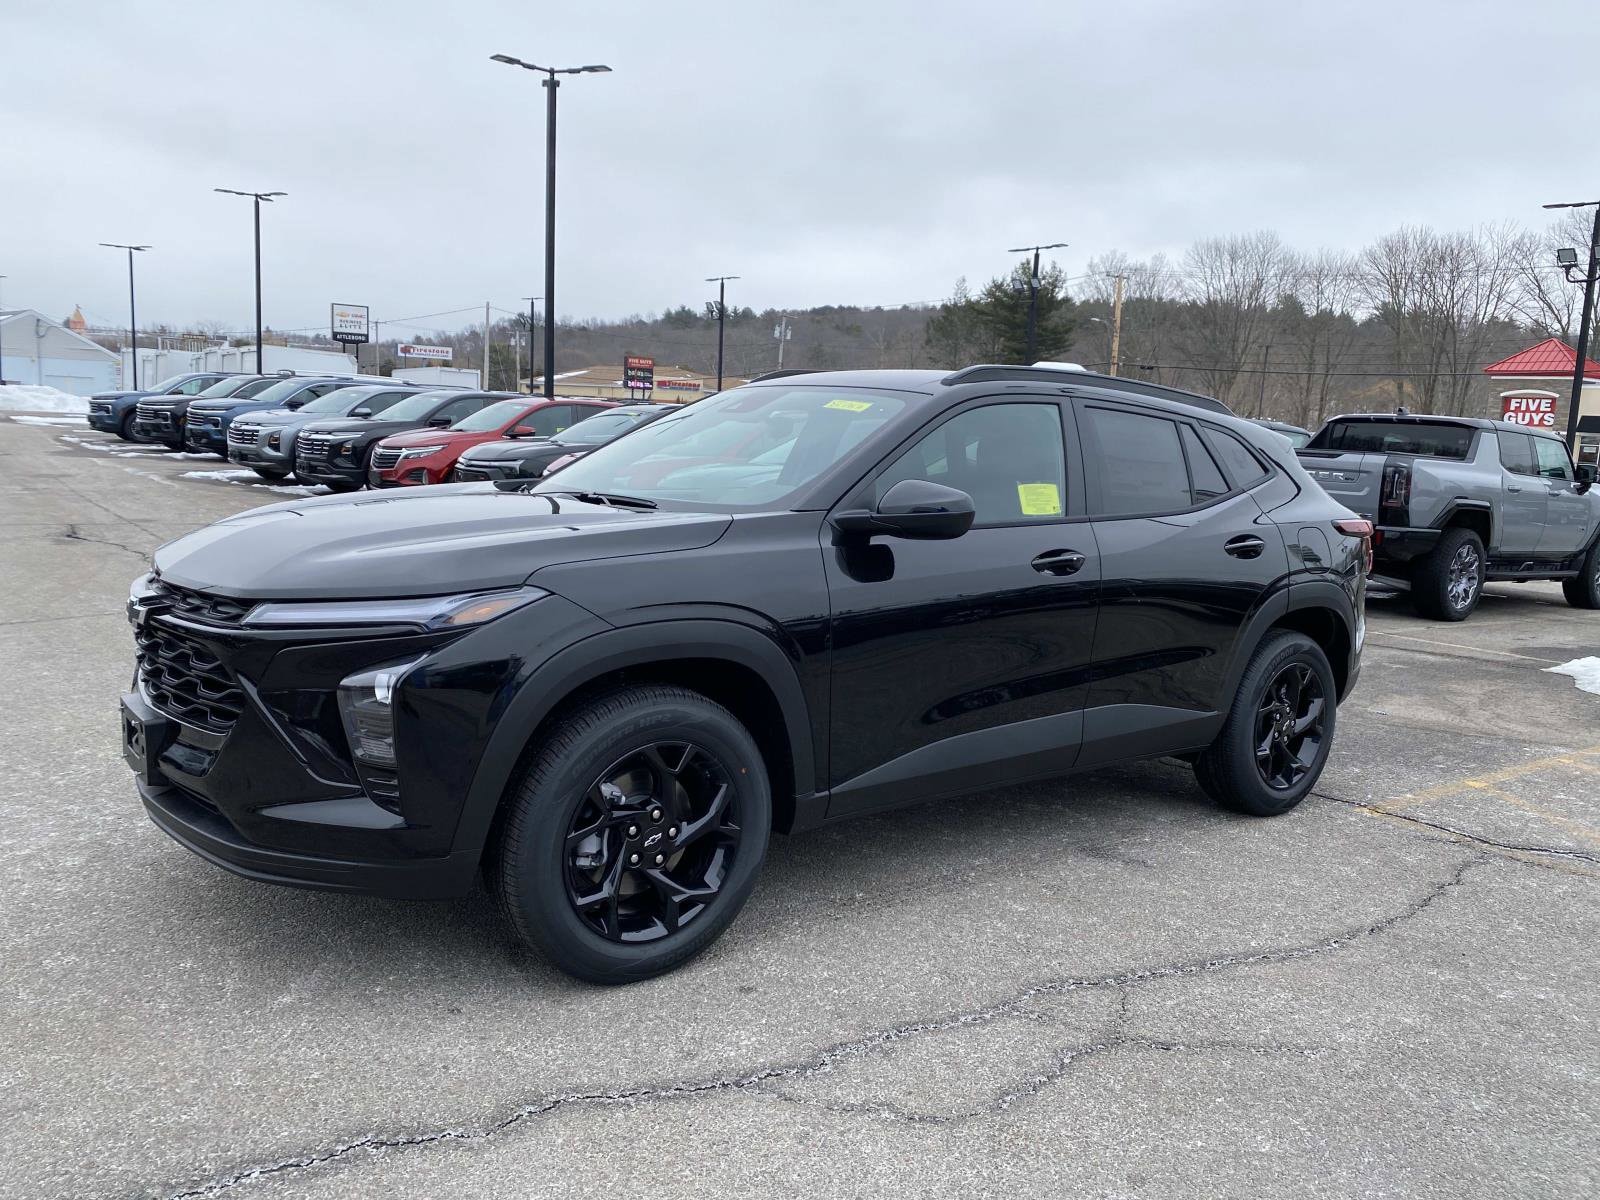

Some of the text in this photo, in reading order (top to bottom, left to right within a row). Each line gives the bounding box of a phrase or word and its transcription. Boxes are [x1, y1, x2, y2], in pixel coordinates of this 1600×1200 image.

[411, 346, 449, 355] Firestone
[1509, 398, 1552, 412] FIVE
[1503, 411, 1555, 426] GUYS
